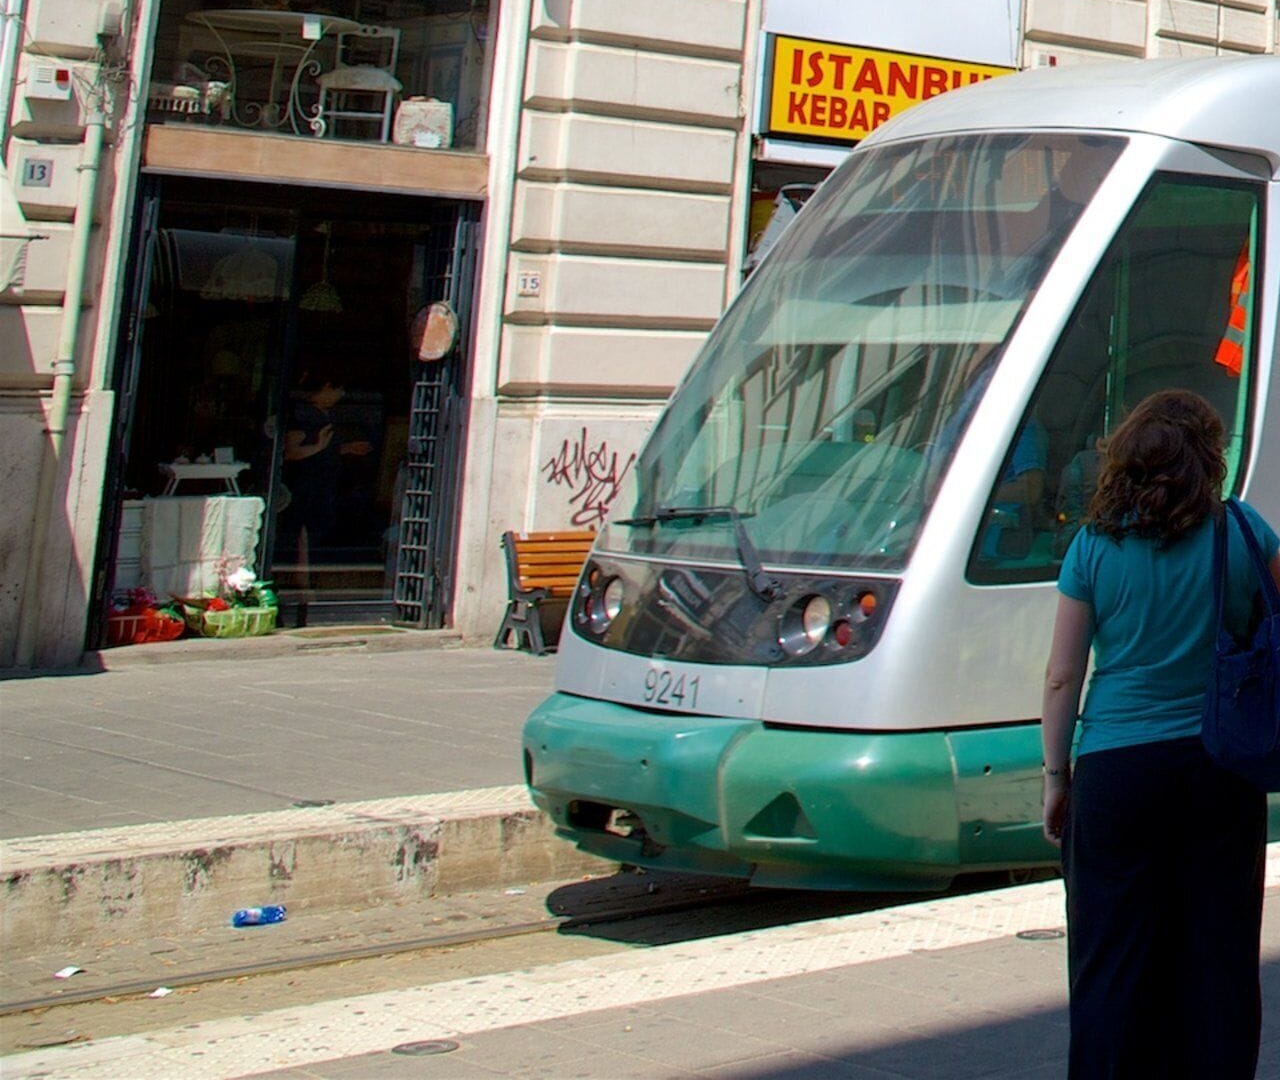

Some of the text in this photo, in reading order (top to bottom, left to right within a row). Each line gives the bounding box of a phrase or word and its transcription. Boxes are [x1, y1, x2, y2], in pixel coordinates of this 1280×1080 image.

[790, 48, 993, 101] ISTANB
[29, 164, 47, 181] 13
[520, 277, 540, 290] 15
[644, 668, 701, 709] 9241
